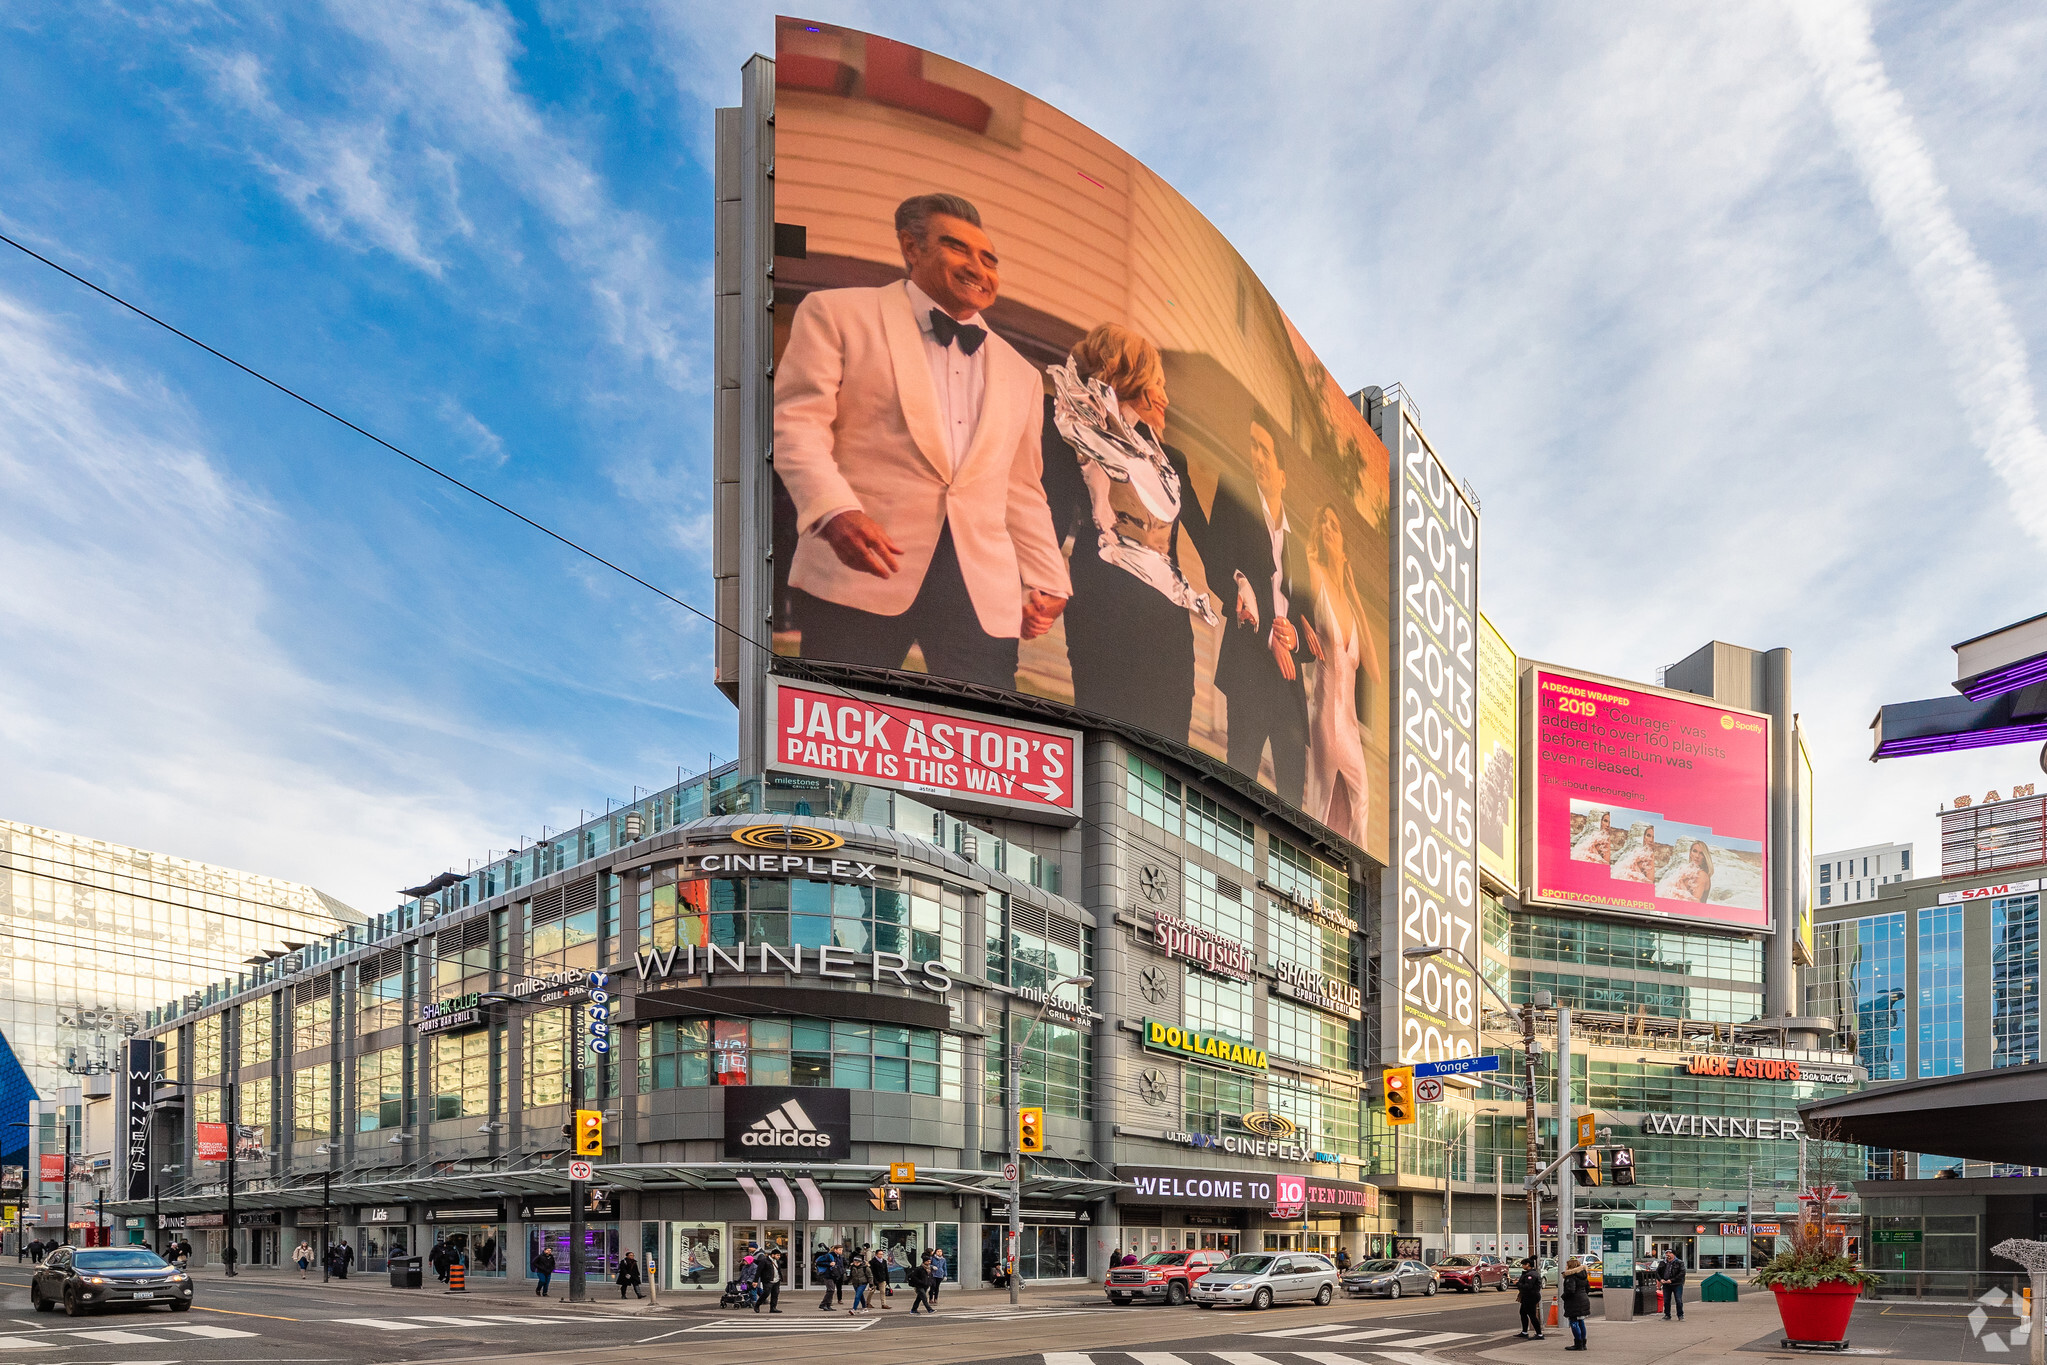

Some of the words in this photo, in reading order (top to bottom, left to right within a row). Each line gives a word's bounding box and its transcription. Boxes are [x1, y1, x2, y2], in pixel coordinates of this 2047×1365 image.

[1406, 423, 1474, 549] 2010
[1406, 489, 1470, 609] 2011
[1406, 555, 1472, 672] 2012
[1406, 621, 1472, 728] 2013
[1541, 681, 1549, 690] A
[1550, 683, 1587, 698] DECADE
[1587, 690, 1630, 706] WRAPPED
[1541, 694, 1556, 709] In
[1558, 696, 1600, 719] 2019,
[1680, 724, 1707, 739] was
[1735, 720, 1763, 734] Spotify
[786, 697, 891, 750] JACK
[902, 718, 1064, 778] ASTOR'S
[1406, 688, 1473, 789] 2014
[1542, 712, 1589, 732] added
[1590, 720, 1606, 736] to
[1609, 729, 1641, 743] over
[1643, 732, 1669, 748] 160
[1672, 738, 1726, 760] playlists
[1542, 730, 1590, 750] before
[1592, 739, 1616, 755] the
[1619, 744, 1663, 765] album
[1665, 757, 1693, 769] was
[787, 738, 869, 773] PARTY
[876, 753, 899, 777] IS
[904, 757, 959, 786] THIS
[965, 768, 1018, 795] WAY
[1542, 751, 1577, 766] even
[1580, 757, 1643, 778] released.
[774, 777, 820, 786] milestones
[1542, 773, 1560, 786] Talk
[1562, 776, 1589, 791] about
[1589, 783, 1648, 803] encouraging.
[1953, 783, 2035, 808] SAM
[1405, 754, 1472, 847] 2015
[700, 855, 876, 880] CINEPLEX
[1405, 820, 1472, 907] 2016
[1541, 888, 1656, 910] SPOTIFY.COM/WRAPPED
[1962, 885, 2009, 899] SAM
[1292, 886, 1312, 909] The
[1312, 897, 1335, 920] Beer
[1335, 908, 1358, 932] Store
[1404, 886, 1472, 964] 2017
[513, 968, 583, 997] milestones
[633, 942, 952, 993] WINNERS
[541, 991, 562, 1003] GRILL
[569, 986, 586, 996] BAR
[1277, 959, 1326, 996] SHARK
[1327, 980, 1361, 1009] CLUB
[1405, 960, 1473, 1025] 2018
[1594, 989, 1625, 1002] DMZ
[423, 1000, 452, 1020] SHARK
[454, 992, 478, 1012] CLUB
[588, 971, 609, 1054] Yonge
[1018, 984, 1093, 1017] milestones
[1644, 994, 1674, 1006] DMZ
[418, 1018, 439, 1033] SPORTS
[440, 1014, 452, 1027] BAR
[454, 1011, 470, 1024] GRILL
[1048, 1009, 1070, 1022] GRILL
[1077, 1016, 1092, 1028] BAR
[577, 1011, 585, 1070] DOWNTOWN
[1151, 1021, 1268, 1070] DOLLARAMA
[1434, 1061, 1470, 1073] Yonge
[1688, 1055, 1731, 1076] JACK
[1735, 1058, 1800, 1080] ASTOR'S
[1802, 1071, 1819, 1081] Bar
[1820, 1073, 1833, 1082] and
[1834, 1073, 1854, 1084] Grill
[129, 1071, 150, 1172] WINNERS
[1650, 1112, 1818, 1141] WINNER
[741, 1128, 831, 1147] adidas
[1224, 1136, 1311, 1162] CINEPLEX
[1316, 1152, 1341, 1163] IMAX
[1133, 1177, 1242, 1198] WELCOME
[1249, 1183, 1270, 1200] TO
[1280, 1182, 1301, 1202] 10
[1308, 1186, 1336, 1203] TEN
[1338, 1189, 1369, 1207] DUNDAS
[372, 1209, 388, 1221] Lids
